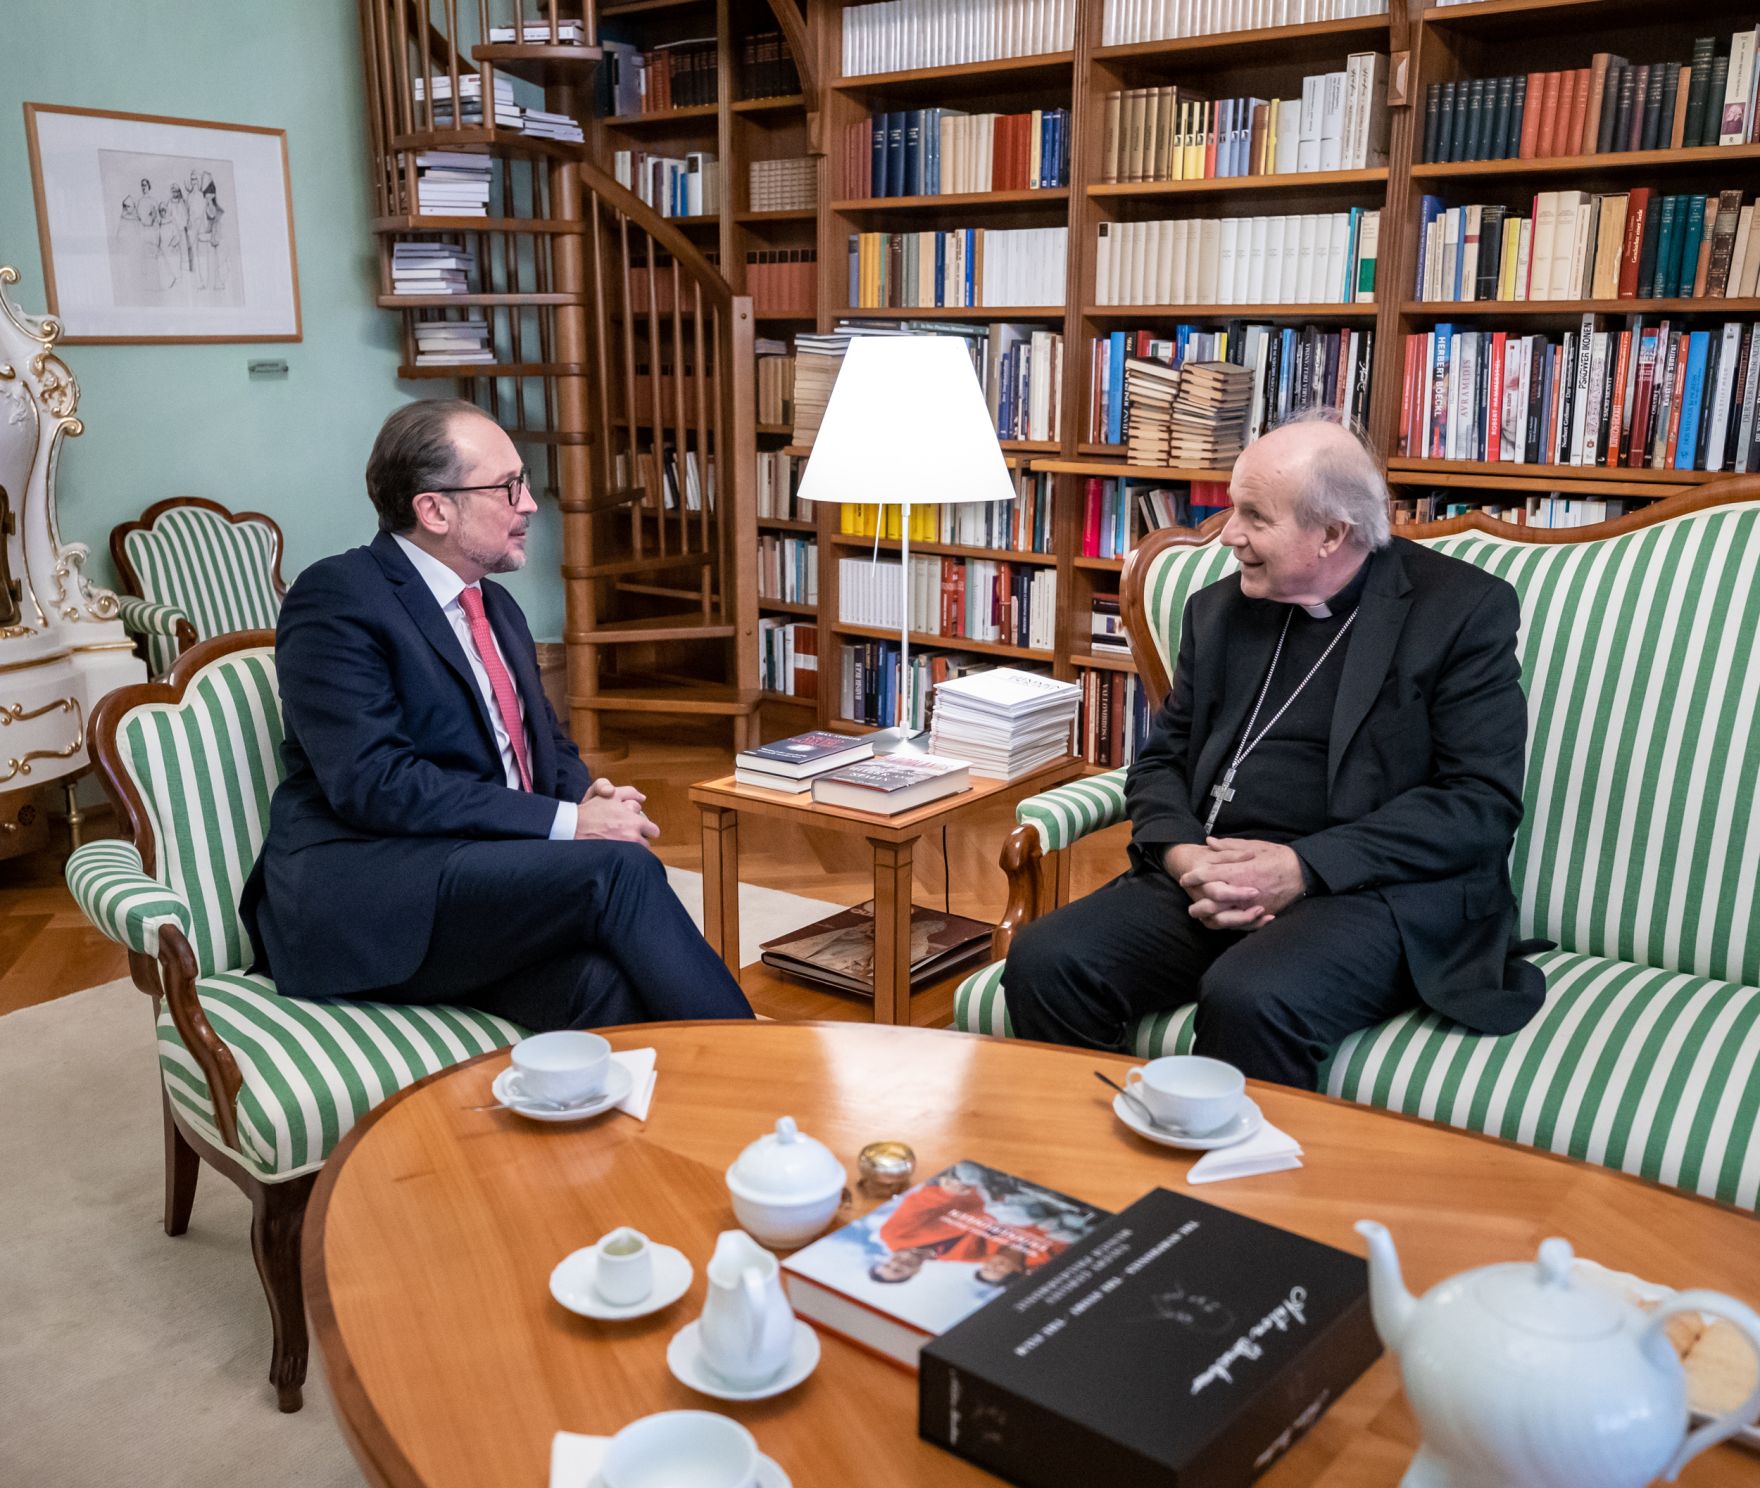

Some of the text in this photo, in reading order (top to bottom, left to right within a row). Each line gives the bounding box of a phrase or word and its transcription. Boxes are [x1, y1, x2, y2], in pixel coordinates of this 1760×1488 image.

[1582, 322, 1592, 350] IKONEN
[1435, 337, 1445, 416] HERBERT BOECKL
[1461, 360, 1471, 417] AVRAMIDIS
